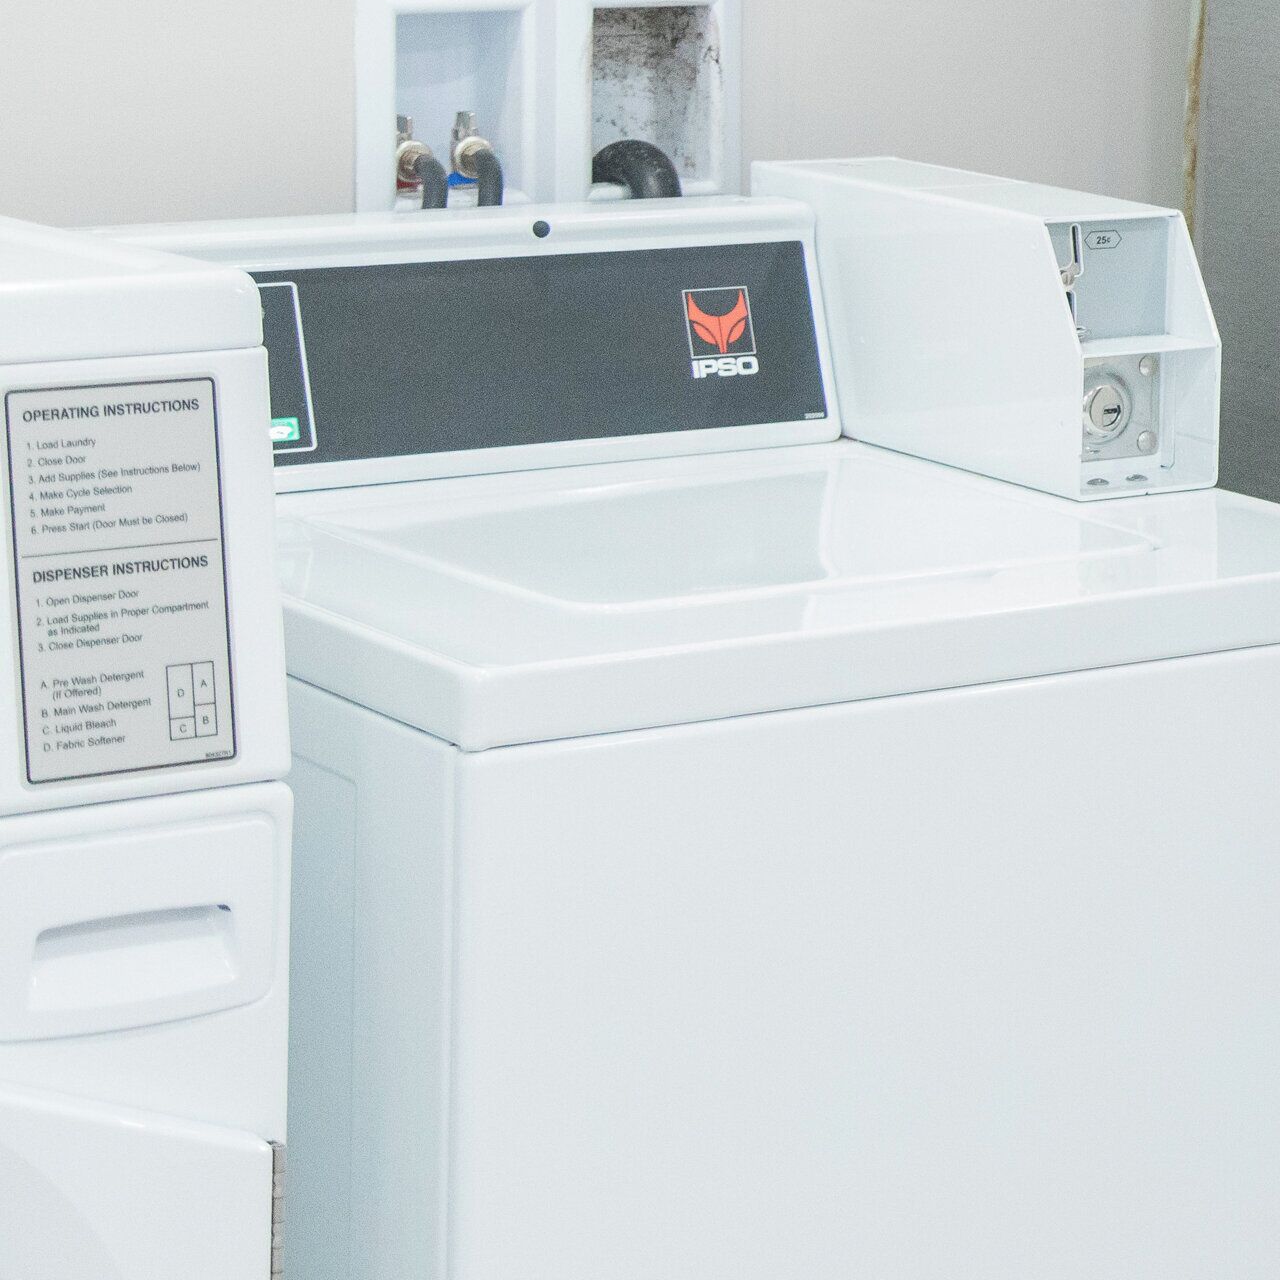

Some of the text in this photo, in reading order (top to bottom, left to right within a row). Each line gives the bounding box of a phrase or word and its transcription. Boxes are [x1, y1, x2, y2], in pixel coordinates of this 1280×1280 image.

[692, 356, 759, 379] IPSO
[23, 399, 199, 422] OPERATING INSTRUCTIONS
[37, 440, 58, 450] Load
[62, 438, 96, 449] Laundry
[27, 456, 86, 467] 2. Close Door
[28, 463, 200, 484] 3. Add Supplies (See Instructions Below)
[40, 491, 63, 500] Make
[66, 489, 90, 499] Cycle
[93, 485, 132, 495] Selection
[30, 503, 105, 518] 5. Make Payment
[31, 513, 188, 534] 6. Press Start (Door Must be Closed)
[33, 556, 209, 583] DISPENSER INSTRUCTIONS
[36, 590, 139, 607] 1. Open Dispenser Door
[37, 601, 209, 626] 2. Load Supplies in Proper Compartment
[61, 624, 100, 635] Indicated
[38, 634, 142, 652] 3. Close Dispenser Door
[53, 679, 69, 687] Pre
[72, 677, 97, 686] Wash
[100, 671, 144, 683] Detergent
[65, 687, 101, 698] Offered)
[178, 689, 184, 697] D
[54, 707, 77, 717] Main
[80, 704, 104, 714] Wash
[108, 698, 151, 711] Detergent
[56, 724, 82, 734] Liquid
[86, 719, 116, 729] Bleach
[203, 716, 209, 724] B
[180, 725, 187, 733] C
[57, 740, 84, 751] Fabric
[88, 736, 125, 746] Softener
